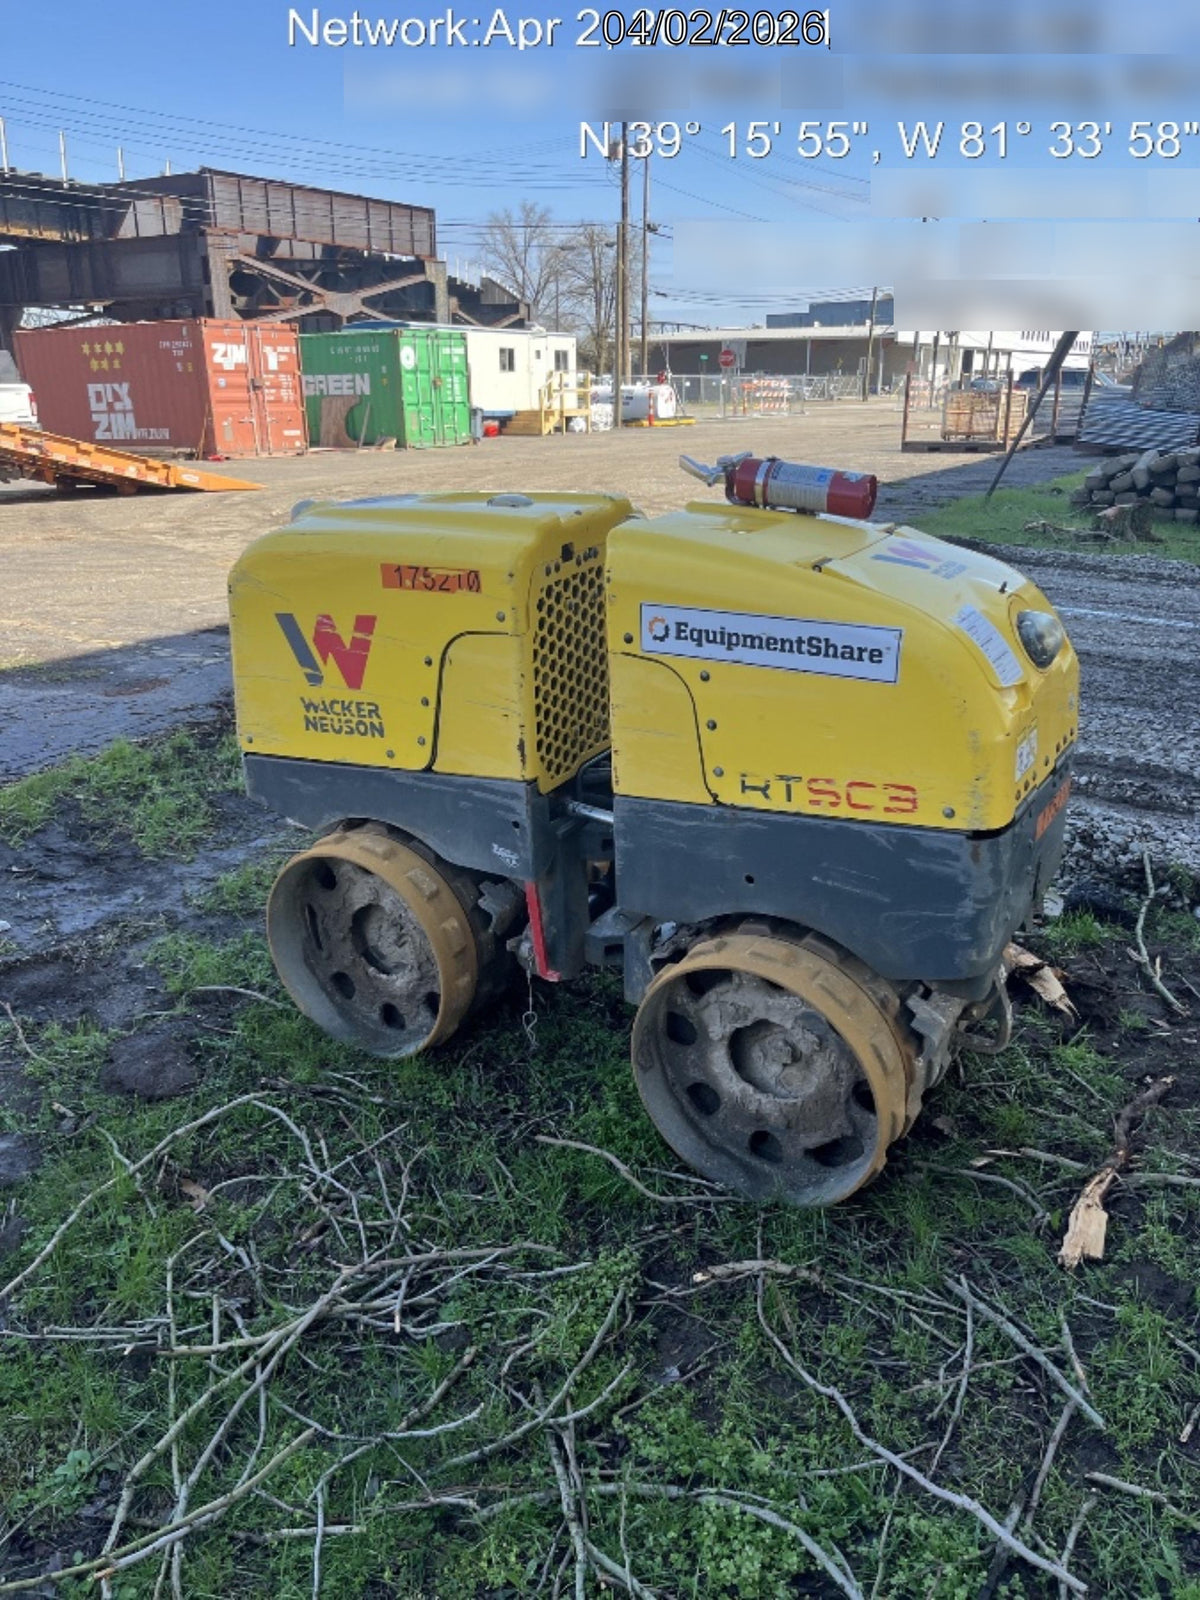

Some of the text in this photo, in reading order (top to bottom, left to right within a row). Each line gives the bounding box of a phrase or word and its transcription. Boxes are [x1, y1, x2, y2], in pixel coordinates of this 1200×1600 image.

[211, 343, 247, 364] ZIM
[301, 373, 371, 396] GREEN
[92, 412, 136, 439] ZIM
[674, 621, 884, 664] EquipmentShare
[300, 696, 383, 720] WACKER
[304, 715, 385, 739] NEUSON
